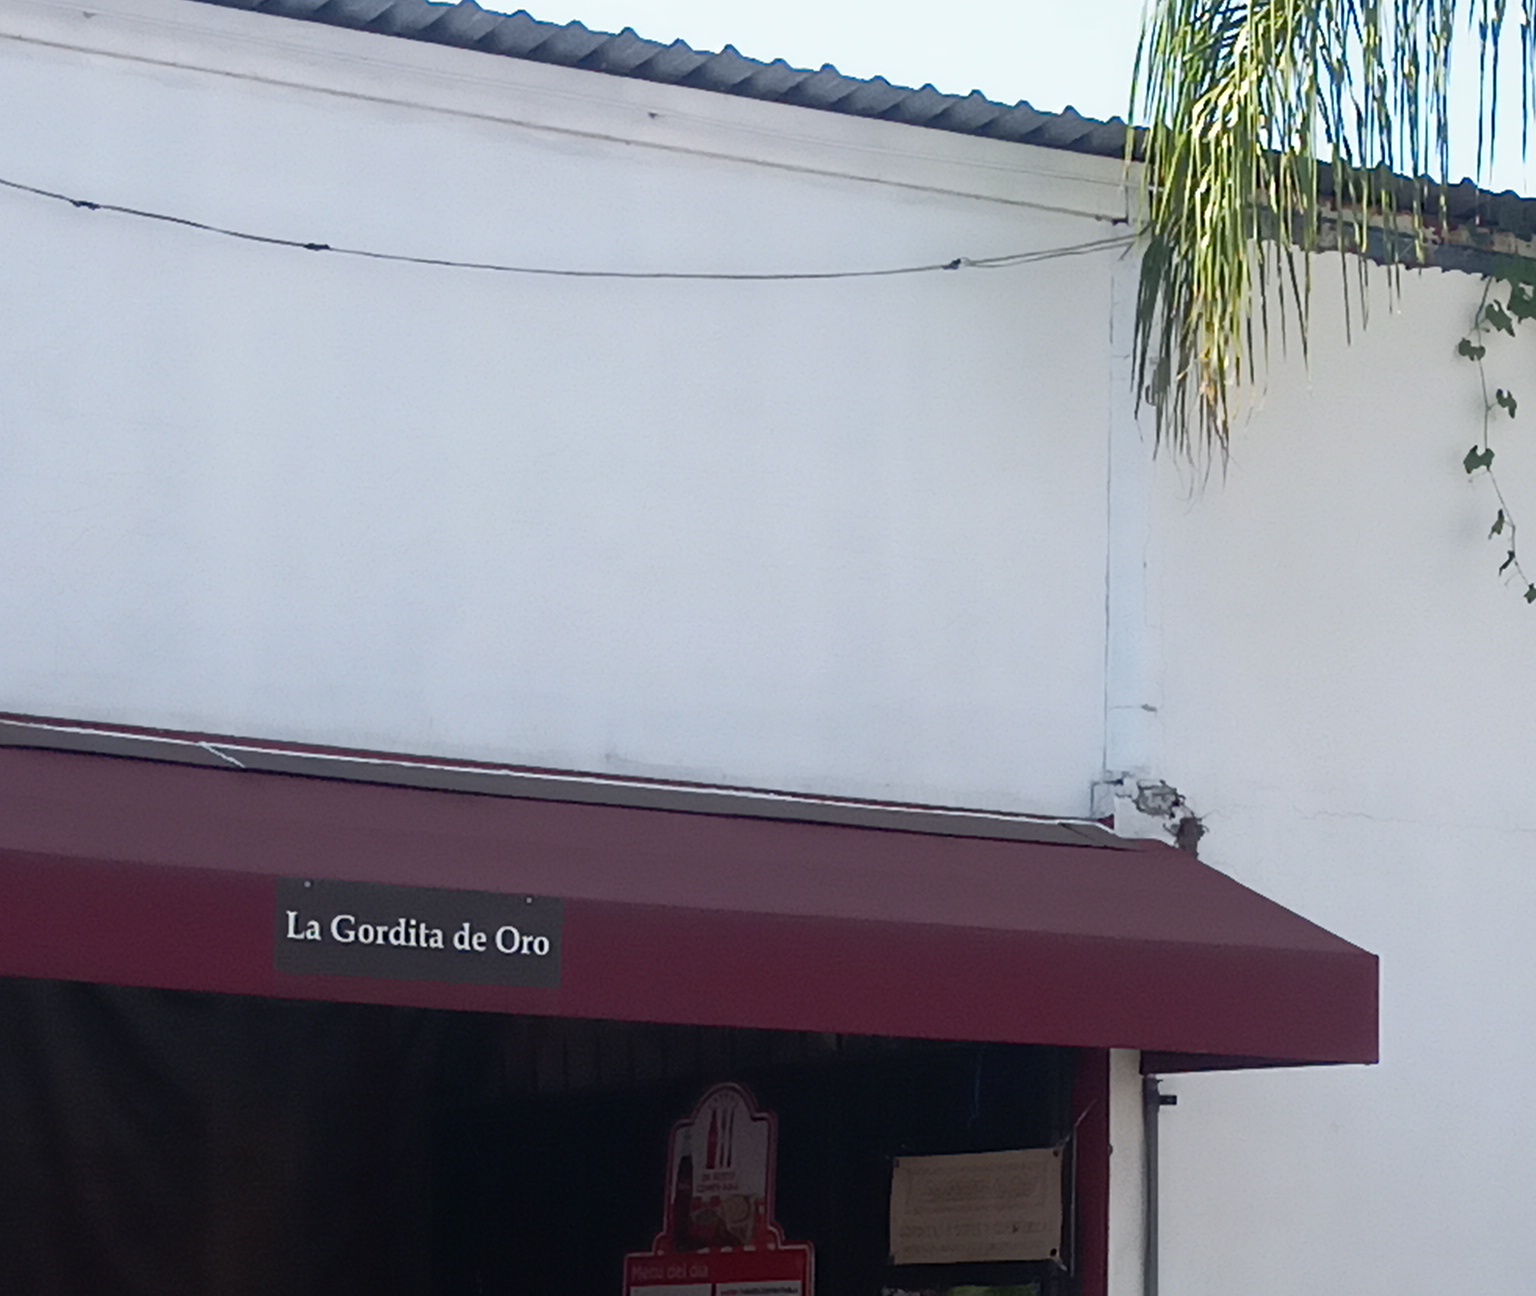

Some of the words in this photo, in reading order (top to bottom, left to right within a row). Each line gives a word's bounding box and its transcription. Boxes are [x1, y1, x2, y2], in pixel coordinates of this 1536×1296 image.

[286, 909, 321, 941] La
[330, 913, 445, 950] Gordita
[452, 923, 486, 953] de
[495, 925, 551, 957] Oro
